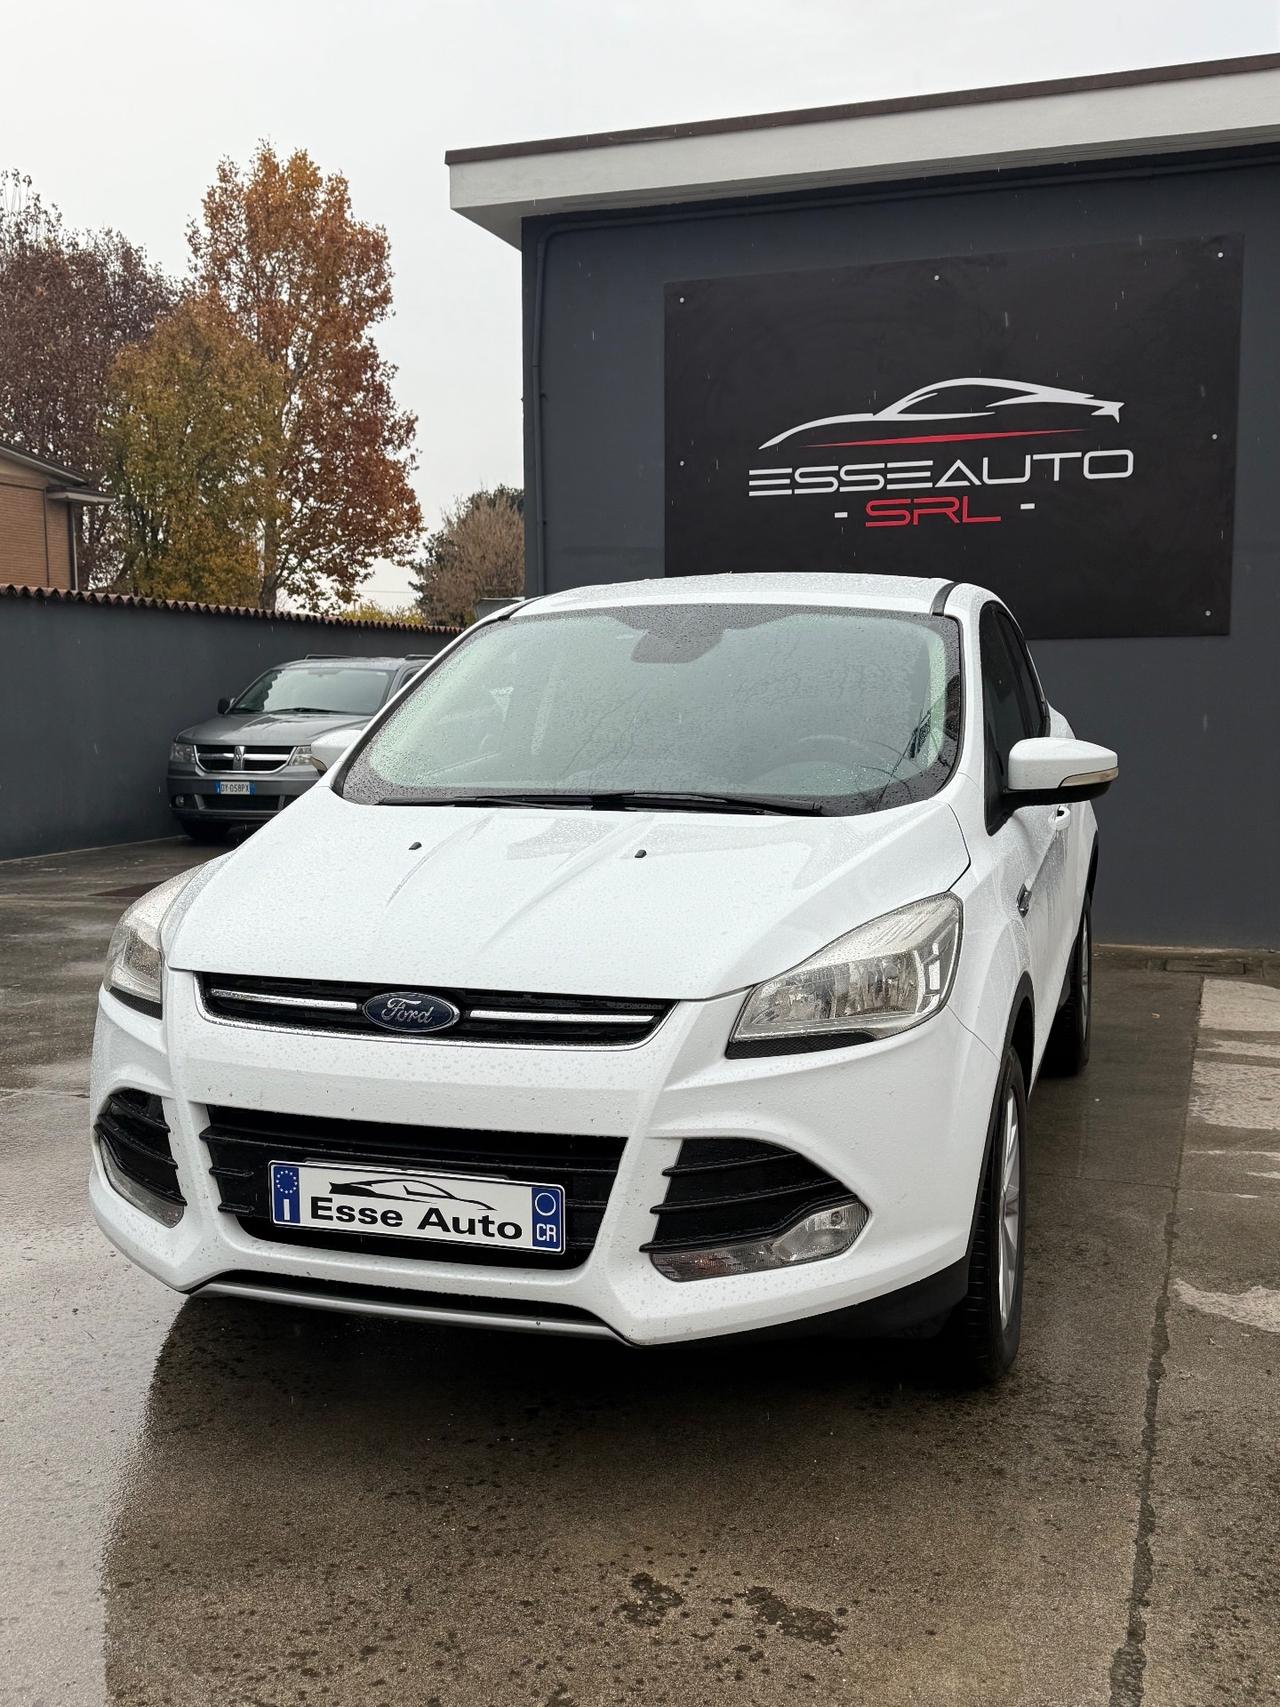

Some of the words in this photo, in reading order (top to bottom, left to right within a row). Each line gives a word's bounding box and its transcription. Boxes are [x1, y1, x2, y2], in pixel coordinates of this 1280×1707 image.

[748, 449, 1134, 497] ESSEAUTO
[864, 496, 1002, 528] SRL
[381, 997, 435, 1023] Ford
[310, 1196, 404, 1228] Esse
[416, 1207, 524, 1240] Auto
[536, 1223, 557, 1243] CR
